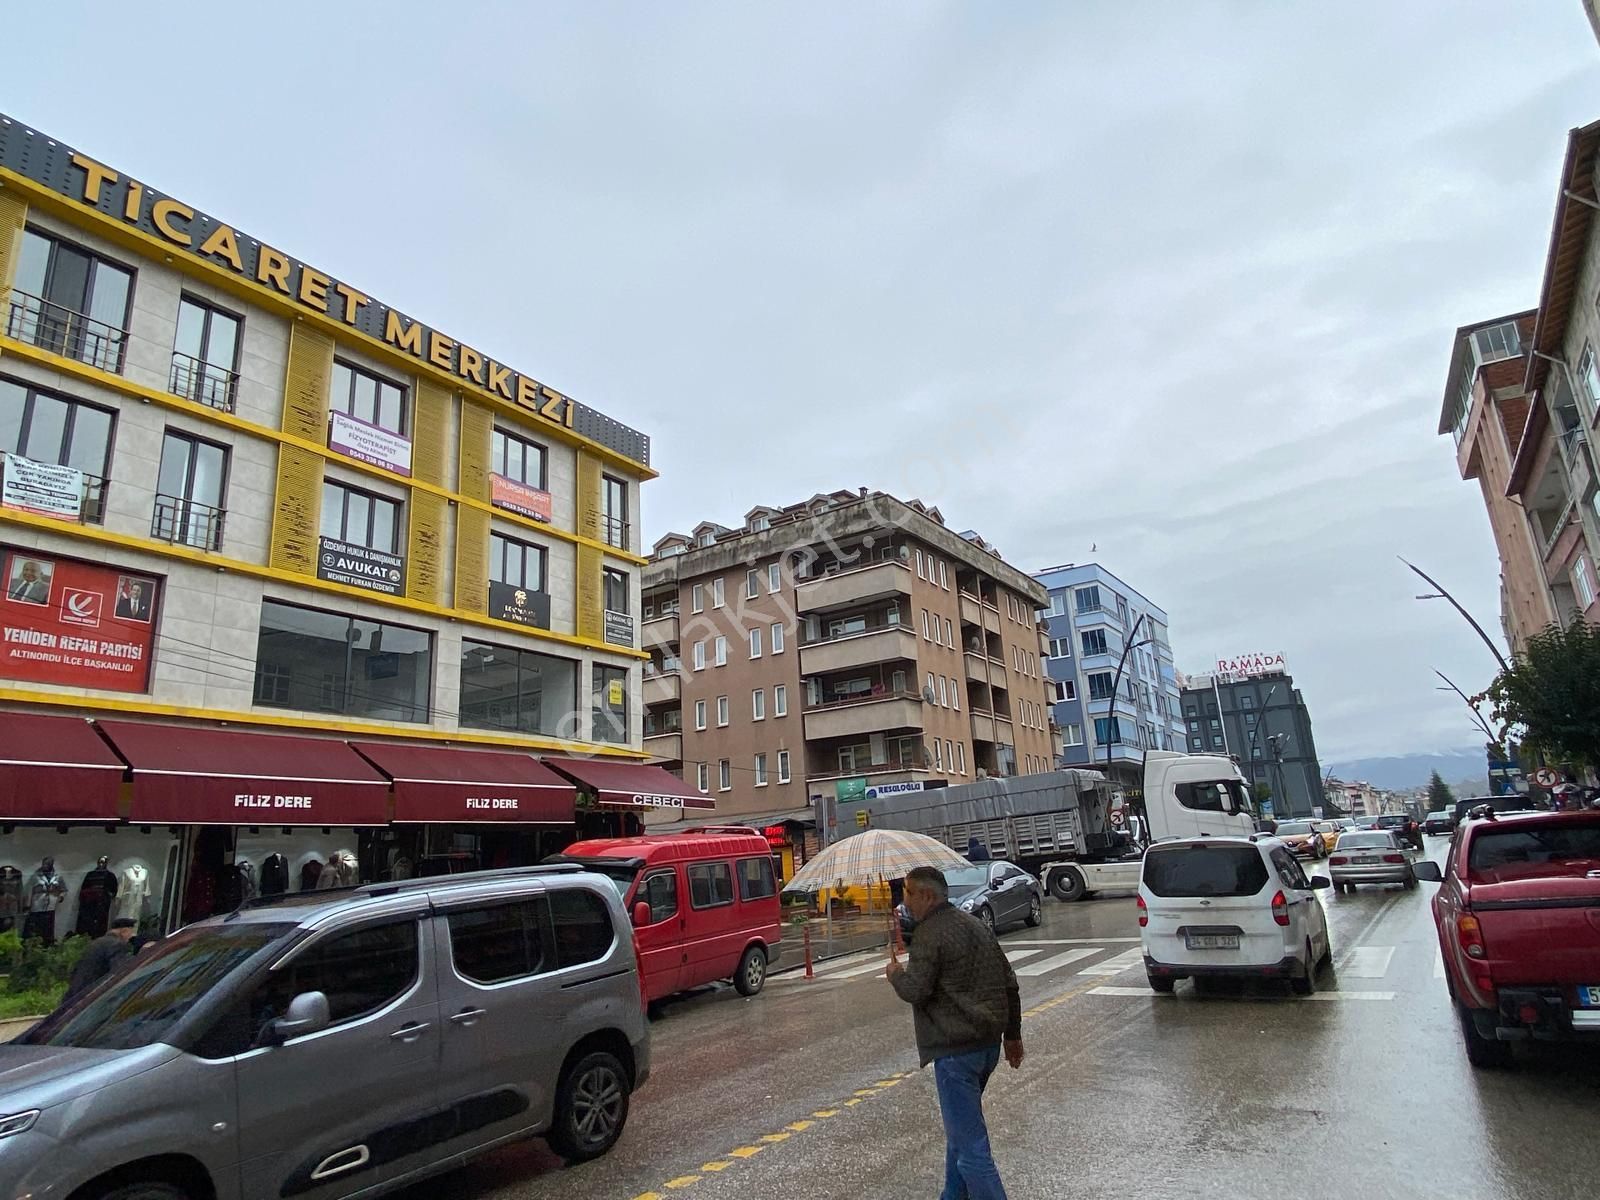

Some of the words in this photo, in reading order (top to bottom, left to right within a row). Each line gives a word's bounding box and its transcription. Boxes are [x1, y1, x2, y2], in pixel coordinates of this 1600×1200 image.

[336, 557, 388, 578] AVUKAT
[327, 571, 350, 583] MEHMET
[3, 626, 57, 648] YENİDEN
[60, 635, 98, 654] REFAH
[100, 641, 143, 660] PARTİSİ
[10, 649, 62, 663] ALTINORDU
[1218, 655, 1285, 672] RAMADA
[274, 795, 312, 808] DERE
[492, 798, 518, 809] DERE
[1588, 988, 1600, 1003] 5
